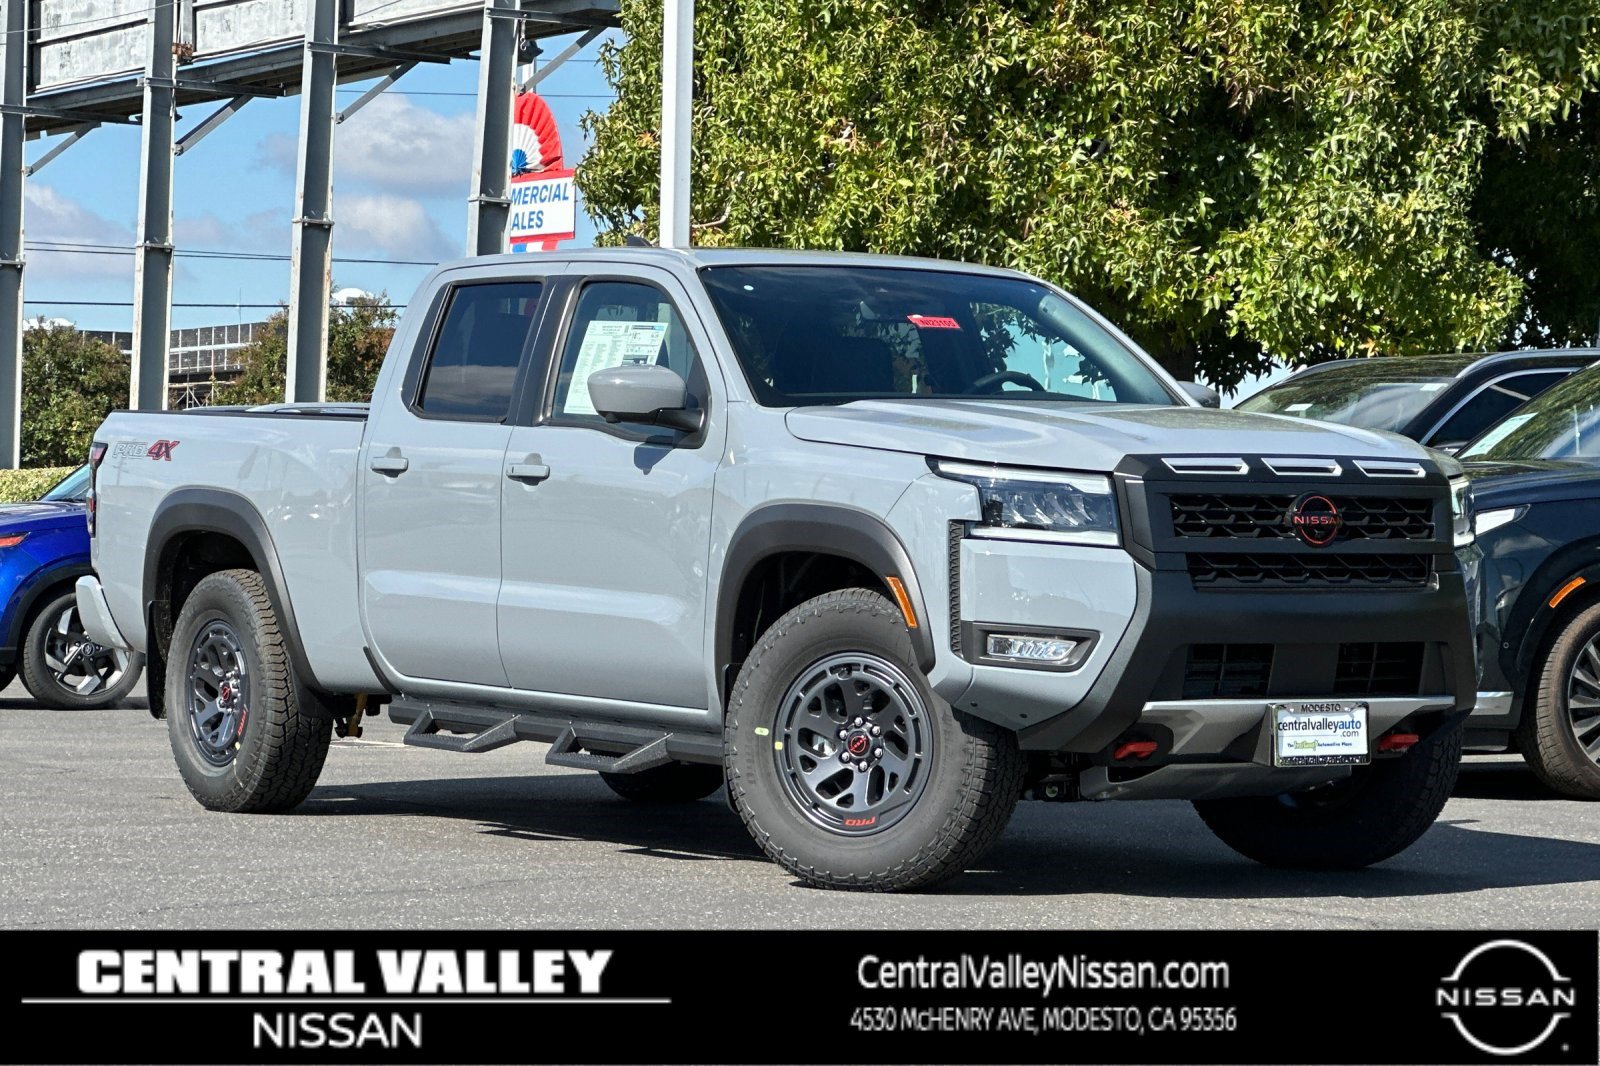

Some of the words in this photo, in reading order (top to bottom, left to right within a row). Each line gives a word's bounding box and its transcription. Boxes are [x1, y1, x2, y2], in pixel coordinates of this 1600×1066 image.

[511, 210, 544, 231] ALES
[1300, 703, 1341, 712] MODESTO
[1278, 718, 1361, 733] centralvalleyauto
[845, 816, 876, 826] PRO
